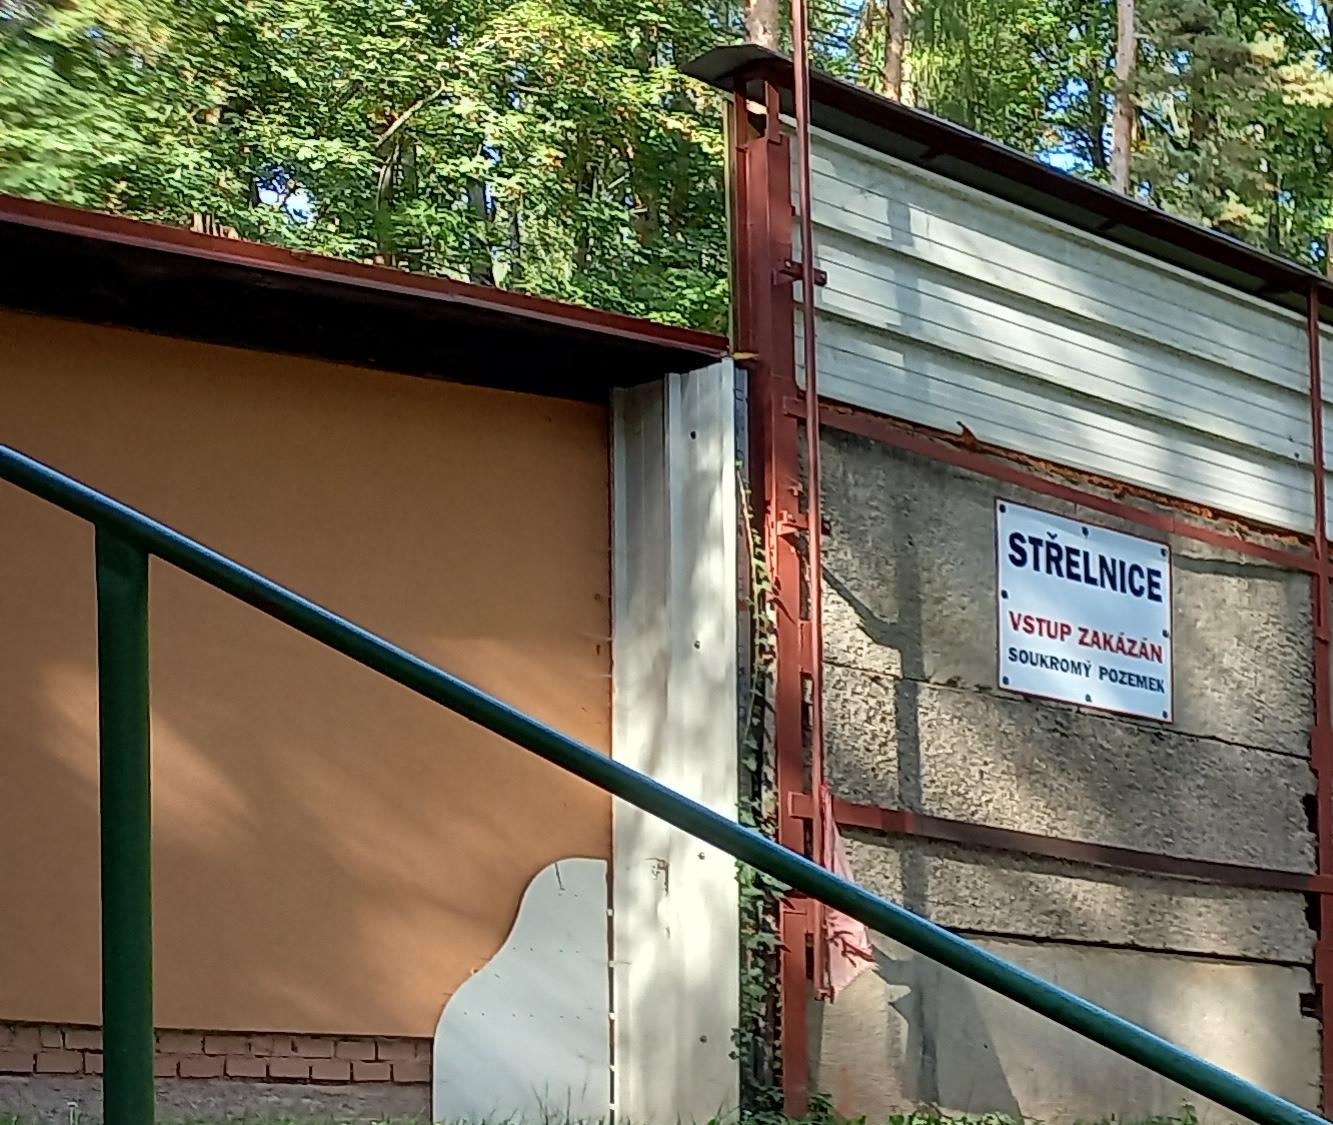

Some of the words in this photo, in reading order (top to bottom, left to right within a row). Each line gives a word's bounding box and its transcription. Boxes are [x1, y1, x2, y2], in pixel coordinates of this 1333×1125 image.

[1008, 532, 1163, 603] STŘELNICE
[1009, 611, 1072, 641] VSTUP
[1078, 626, 1163, 664] ZAKÁZÁN
[1008, 646, 1092, 678] SOUKROMÝ
[1099, 665, 1165, 694] POZEMEK
